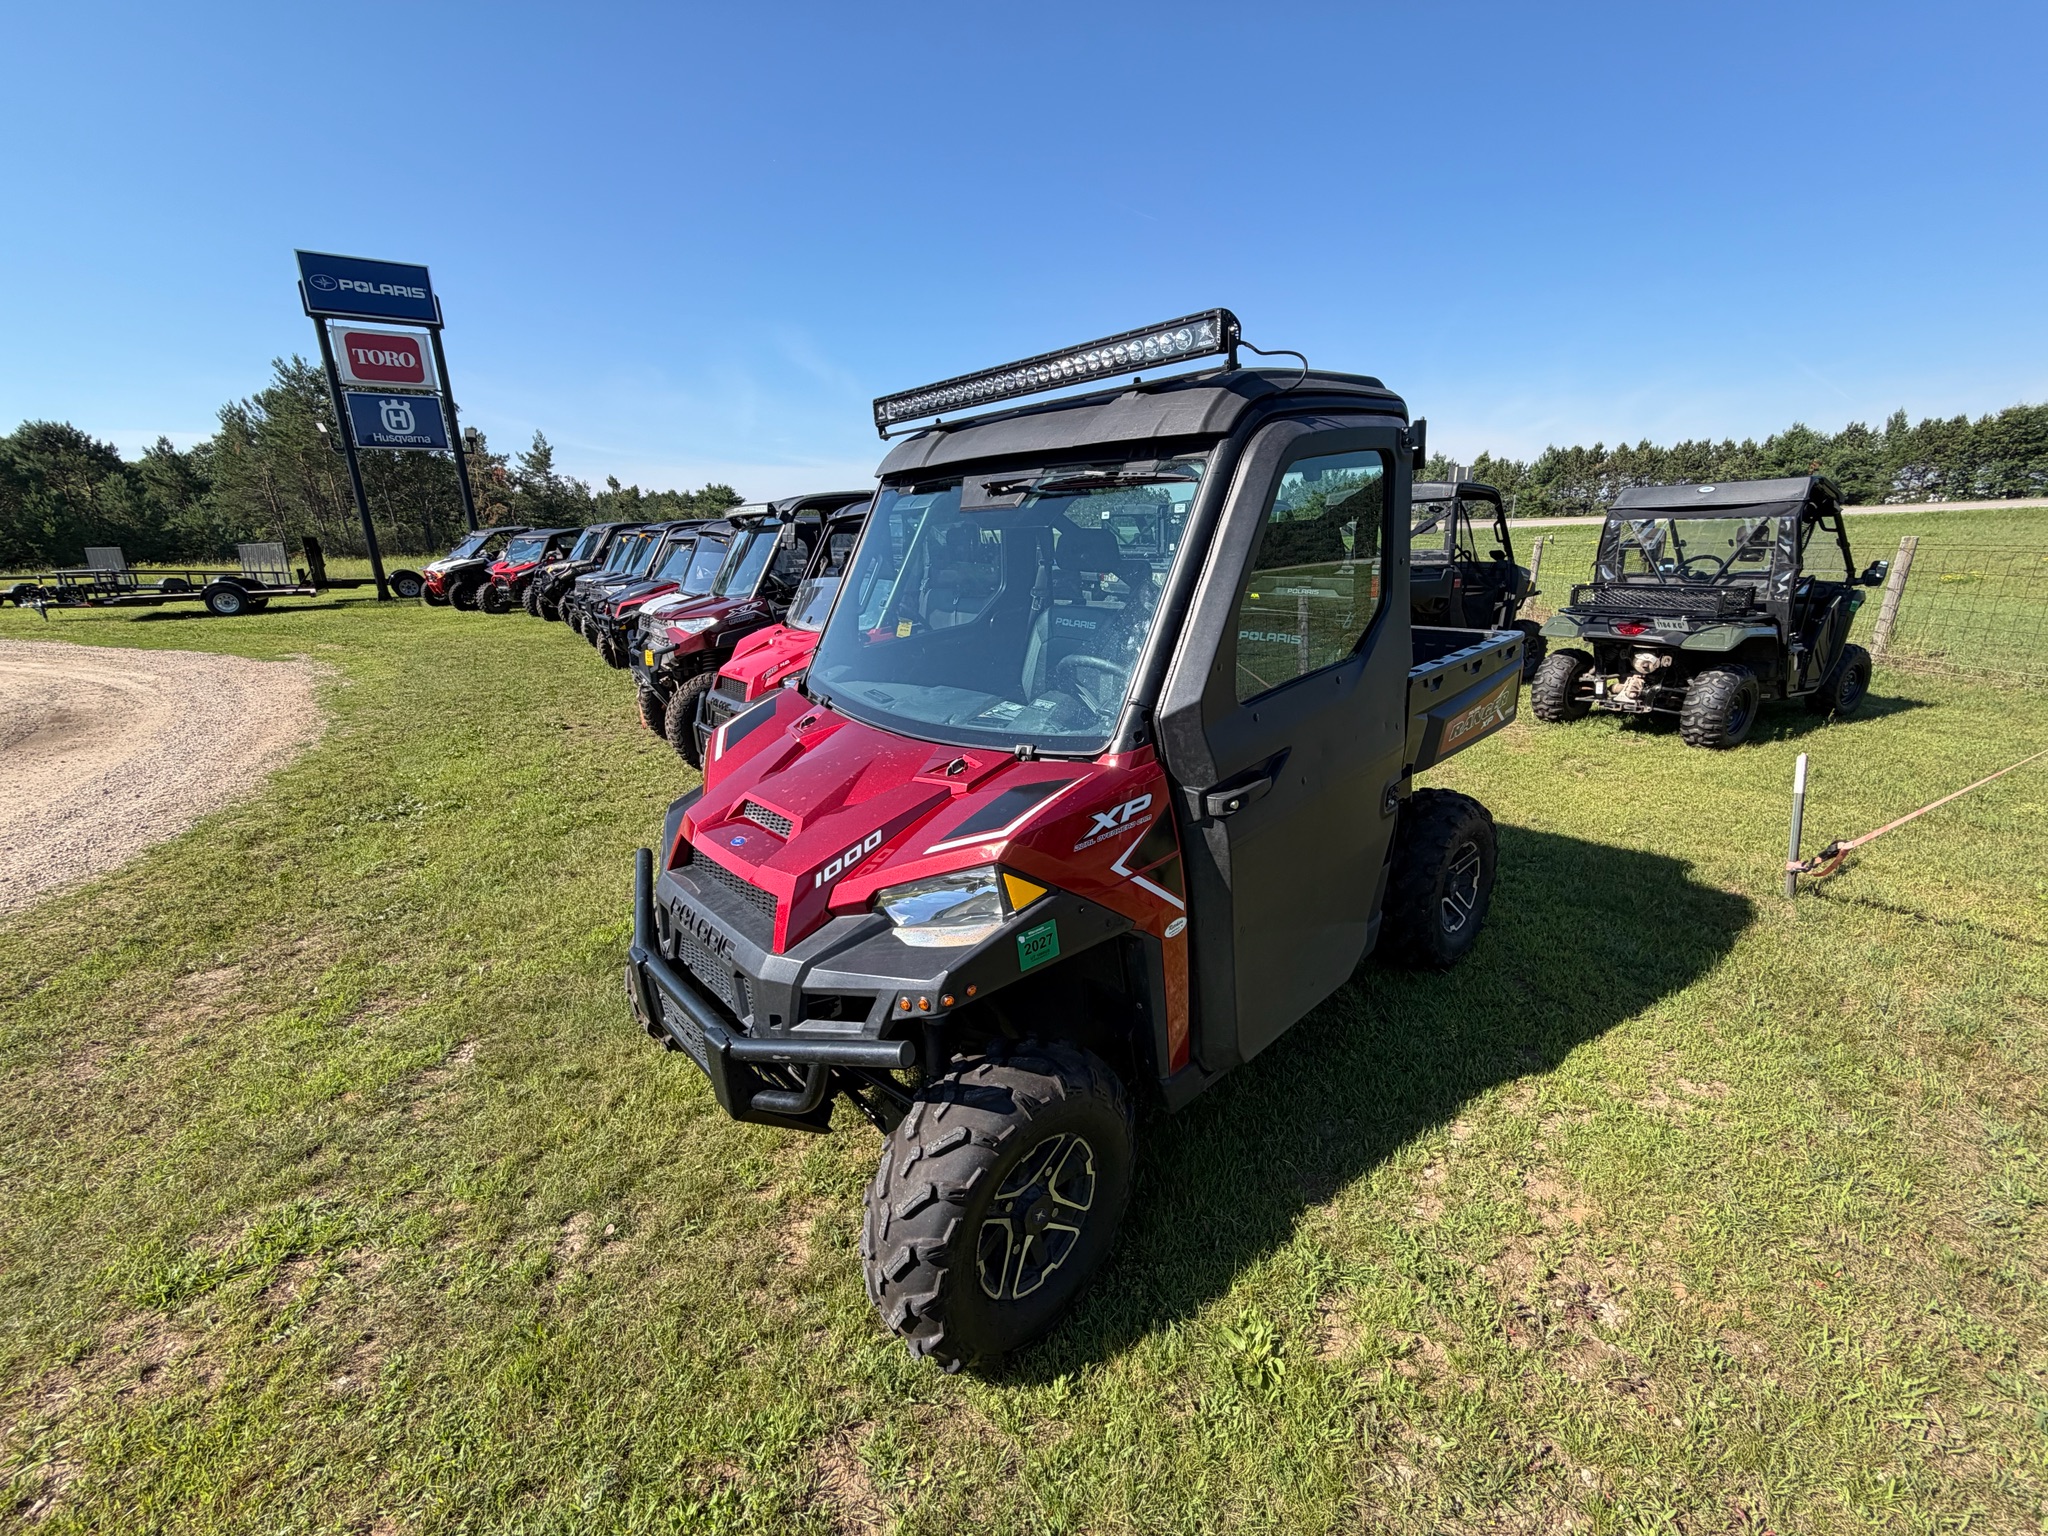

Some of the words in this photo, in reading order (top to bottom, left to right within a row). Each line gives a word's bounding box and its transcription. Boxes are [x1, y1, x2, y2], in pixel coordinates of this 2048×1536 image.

[338, 278, 426, 299] POLARIS
[352, 348, 416, 368] TORO
[373, 433, 431, 444] Husqvarna
[1287, 587, 1320, 595] POLARIS
[1055, 617, 1097, 630] POLARIS
[1239, 630, 1302, 645] POLARIS
[1083, 793, 1153, 839] XP
[815, 829, 882, 889] 1000
[670, 895, 737, 967] POLARIS
[1024, 932, 1053, 956] 2027
